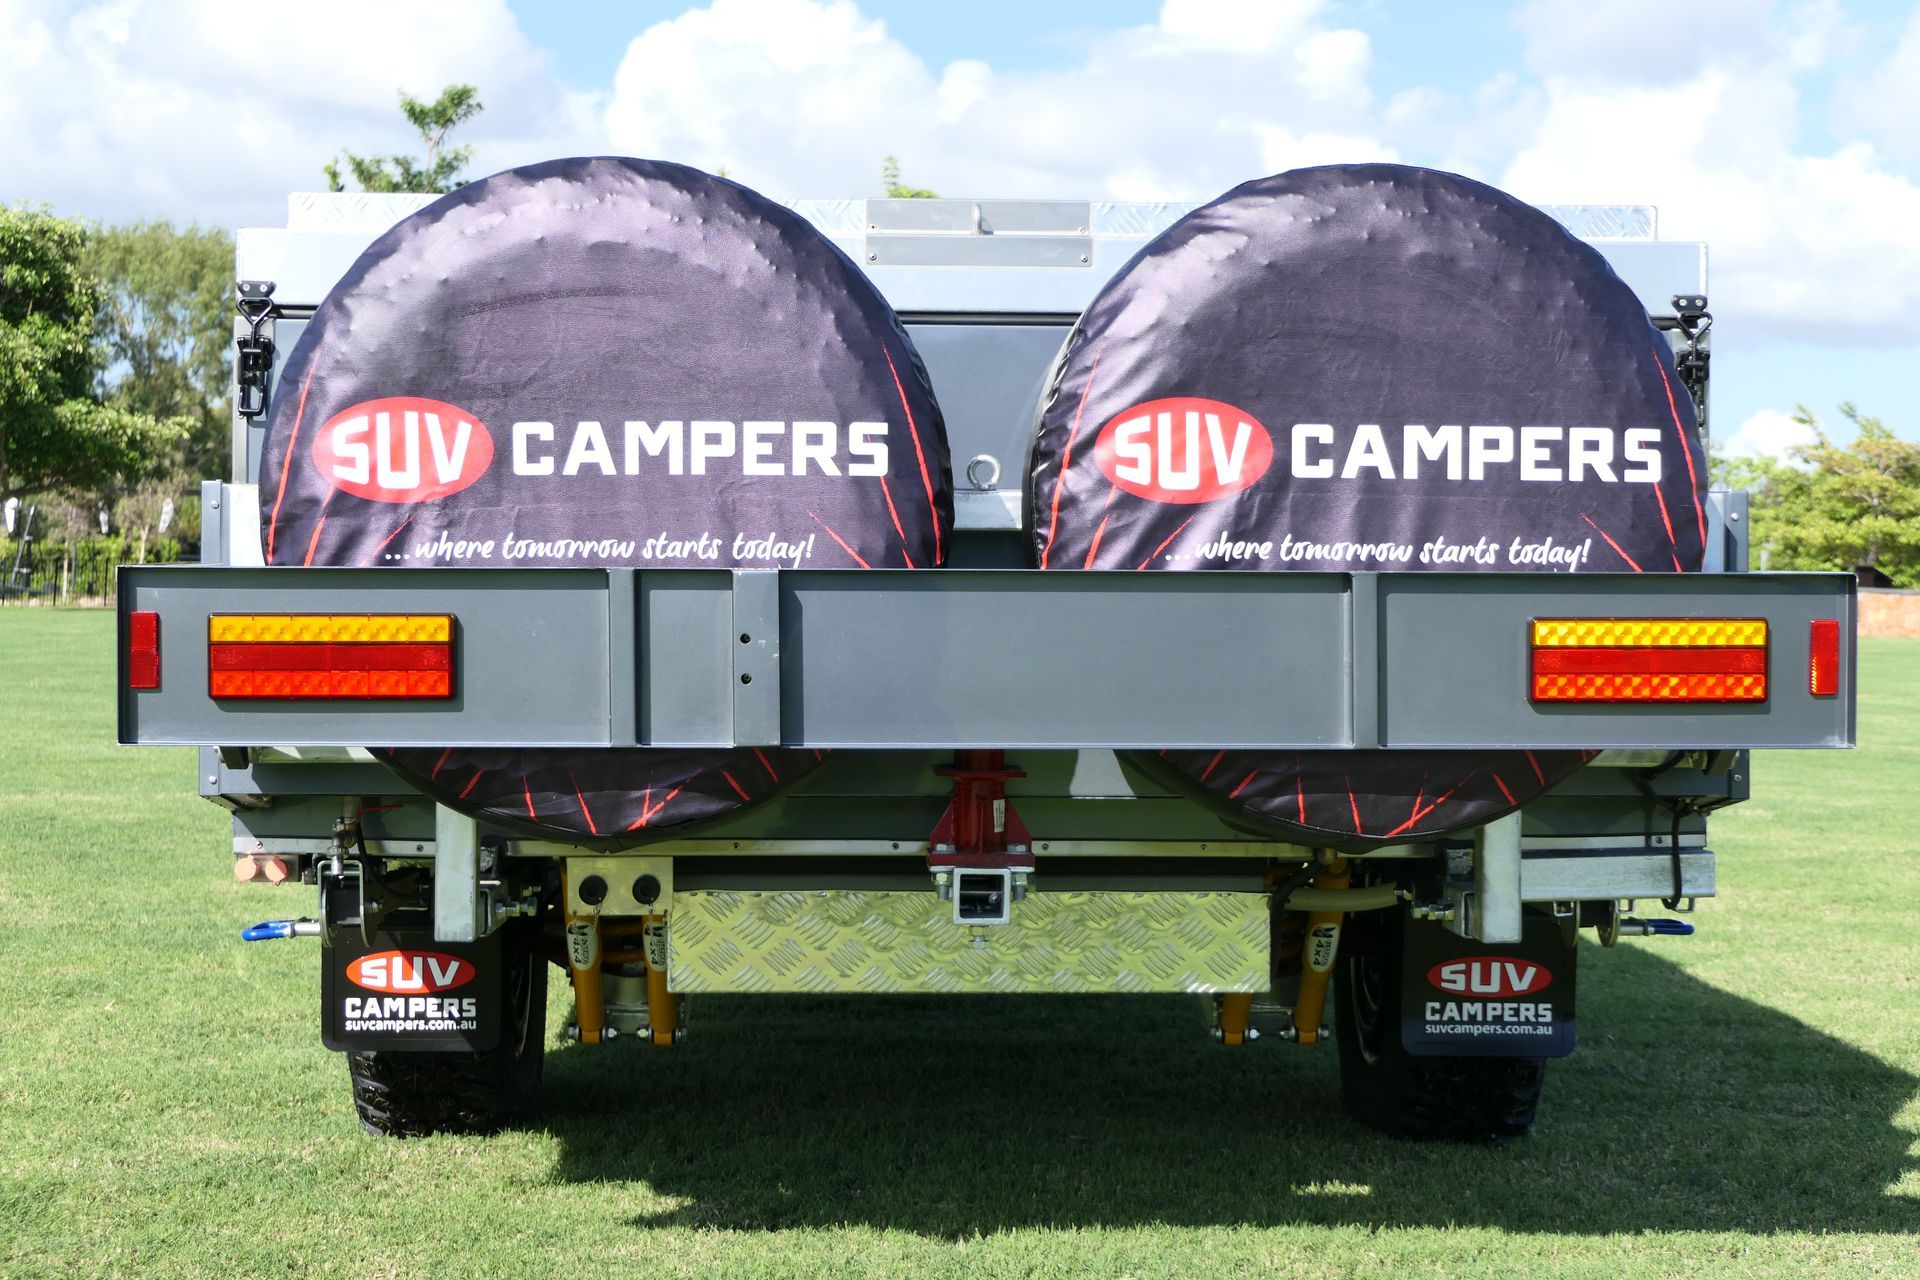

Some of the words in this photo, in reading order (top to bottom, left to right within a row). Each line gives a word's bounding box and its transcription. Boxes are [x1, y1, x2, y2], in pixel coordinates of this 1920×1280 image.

[332, 410, 472, 490] SUV
[512, 421, 889, 477] CAMPERS
[1114, 411, 1253, 491] SUV
[1290, 423, 1662, 484] CAMPERS
[502, 532, 636, 560] tomorrow
[642, 532, 723, 560] starts
[732, 532, 816, 568] today!
[1280, 534, 1413, 562] tomorrow
[1419, 536, 1500, 564] starts
[1508, 536, 1592, 572] today!
[361, 956, 460, 989] SUV
[1440, 961, 1537, 993] SUV
[345, 997, 477, 1018] CAMPERS
[1425, 1002, 1553, 1022] CAMPERS
[345, 1019, 477, 1033] suvcampers.com.au
[1425, 1023, 1553, 1036] suvcampers.com.au
